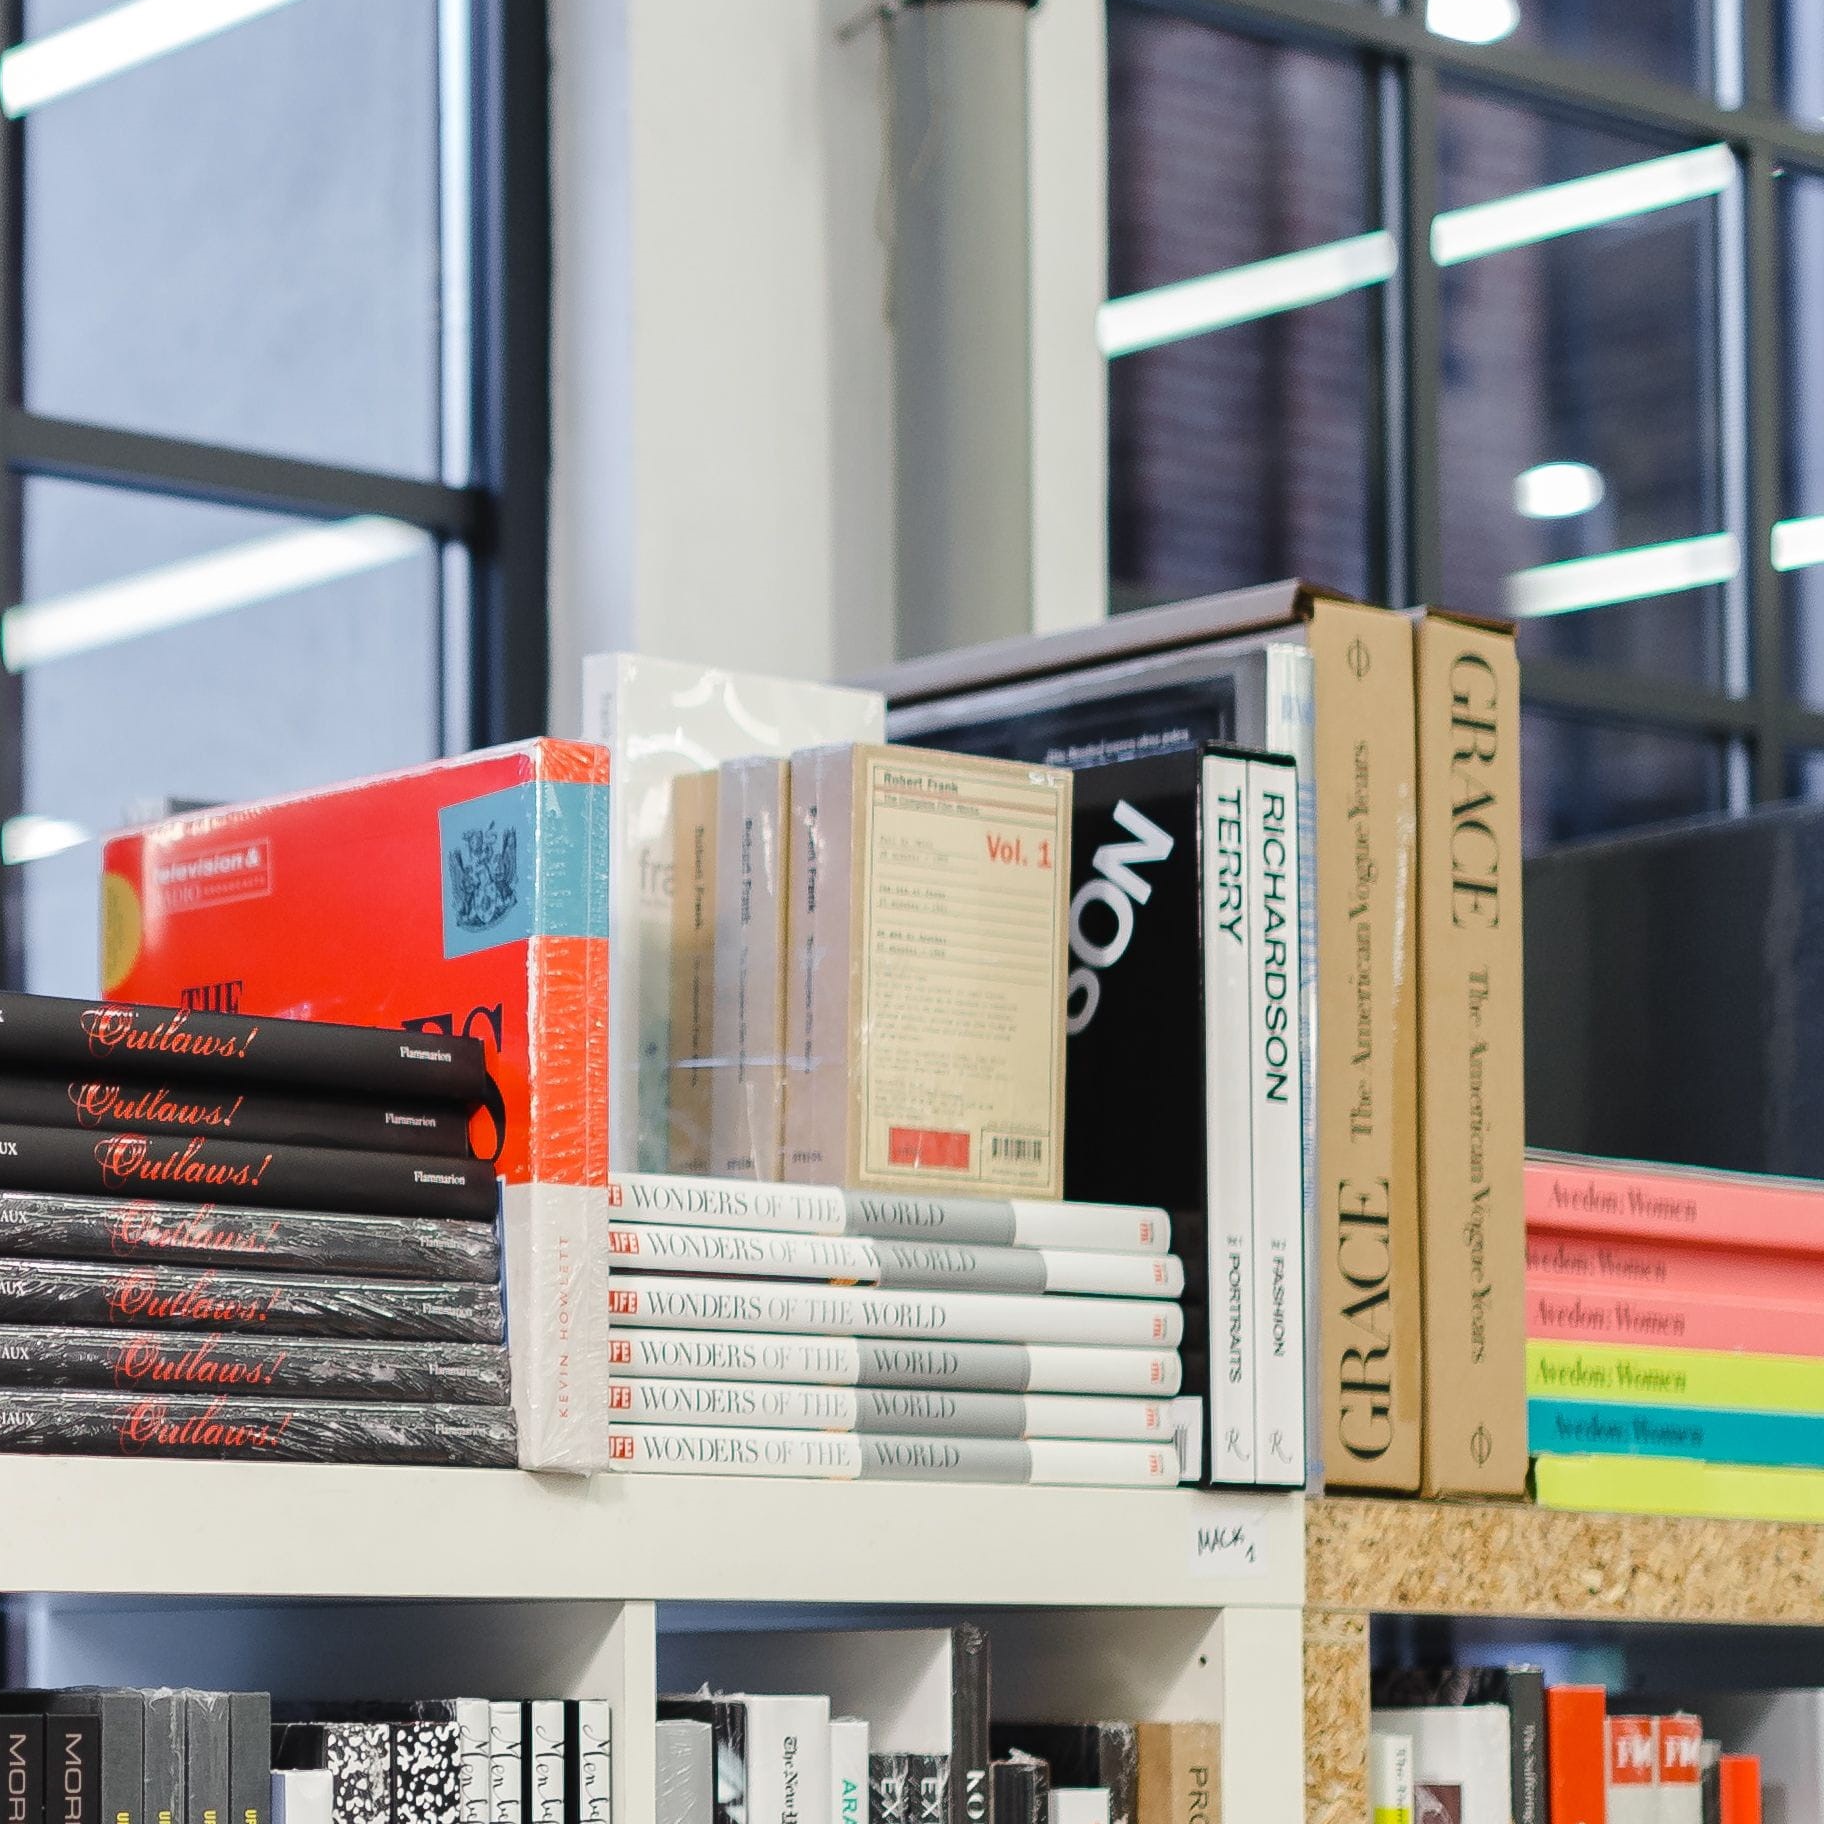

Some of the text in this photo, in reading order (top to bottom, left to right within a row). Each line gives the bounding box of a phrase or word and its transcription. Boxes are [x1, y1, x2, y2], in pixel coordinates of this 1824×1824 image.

[987, 831, 1053, 868] Vol. 1
[1216, 789, 1243, 946] TERRY
[1449, 653, 1501, 930] GRACE
[1261, 791, 1289, 1104] RICHARDSON
[81, 1003, 259, 1059] Outlaws!
[400, 1046, 451, 1063] Flammarion
[558, 1235, 571, 1418] KEVIN HOWLETT
[647, 1290, 946, 1329] WONDERS OF THE WORLD
[1337, 1178, 1392, 1464] GRACE
